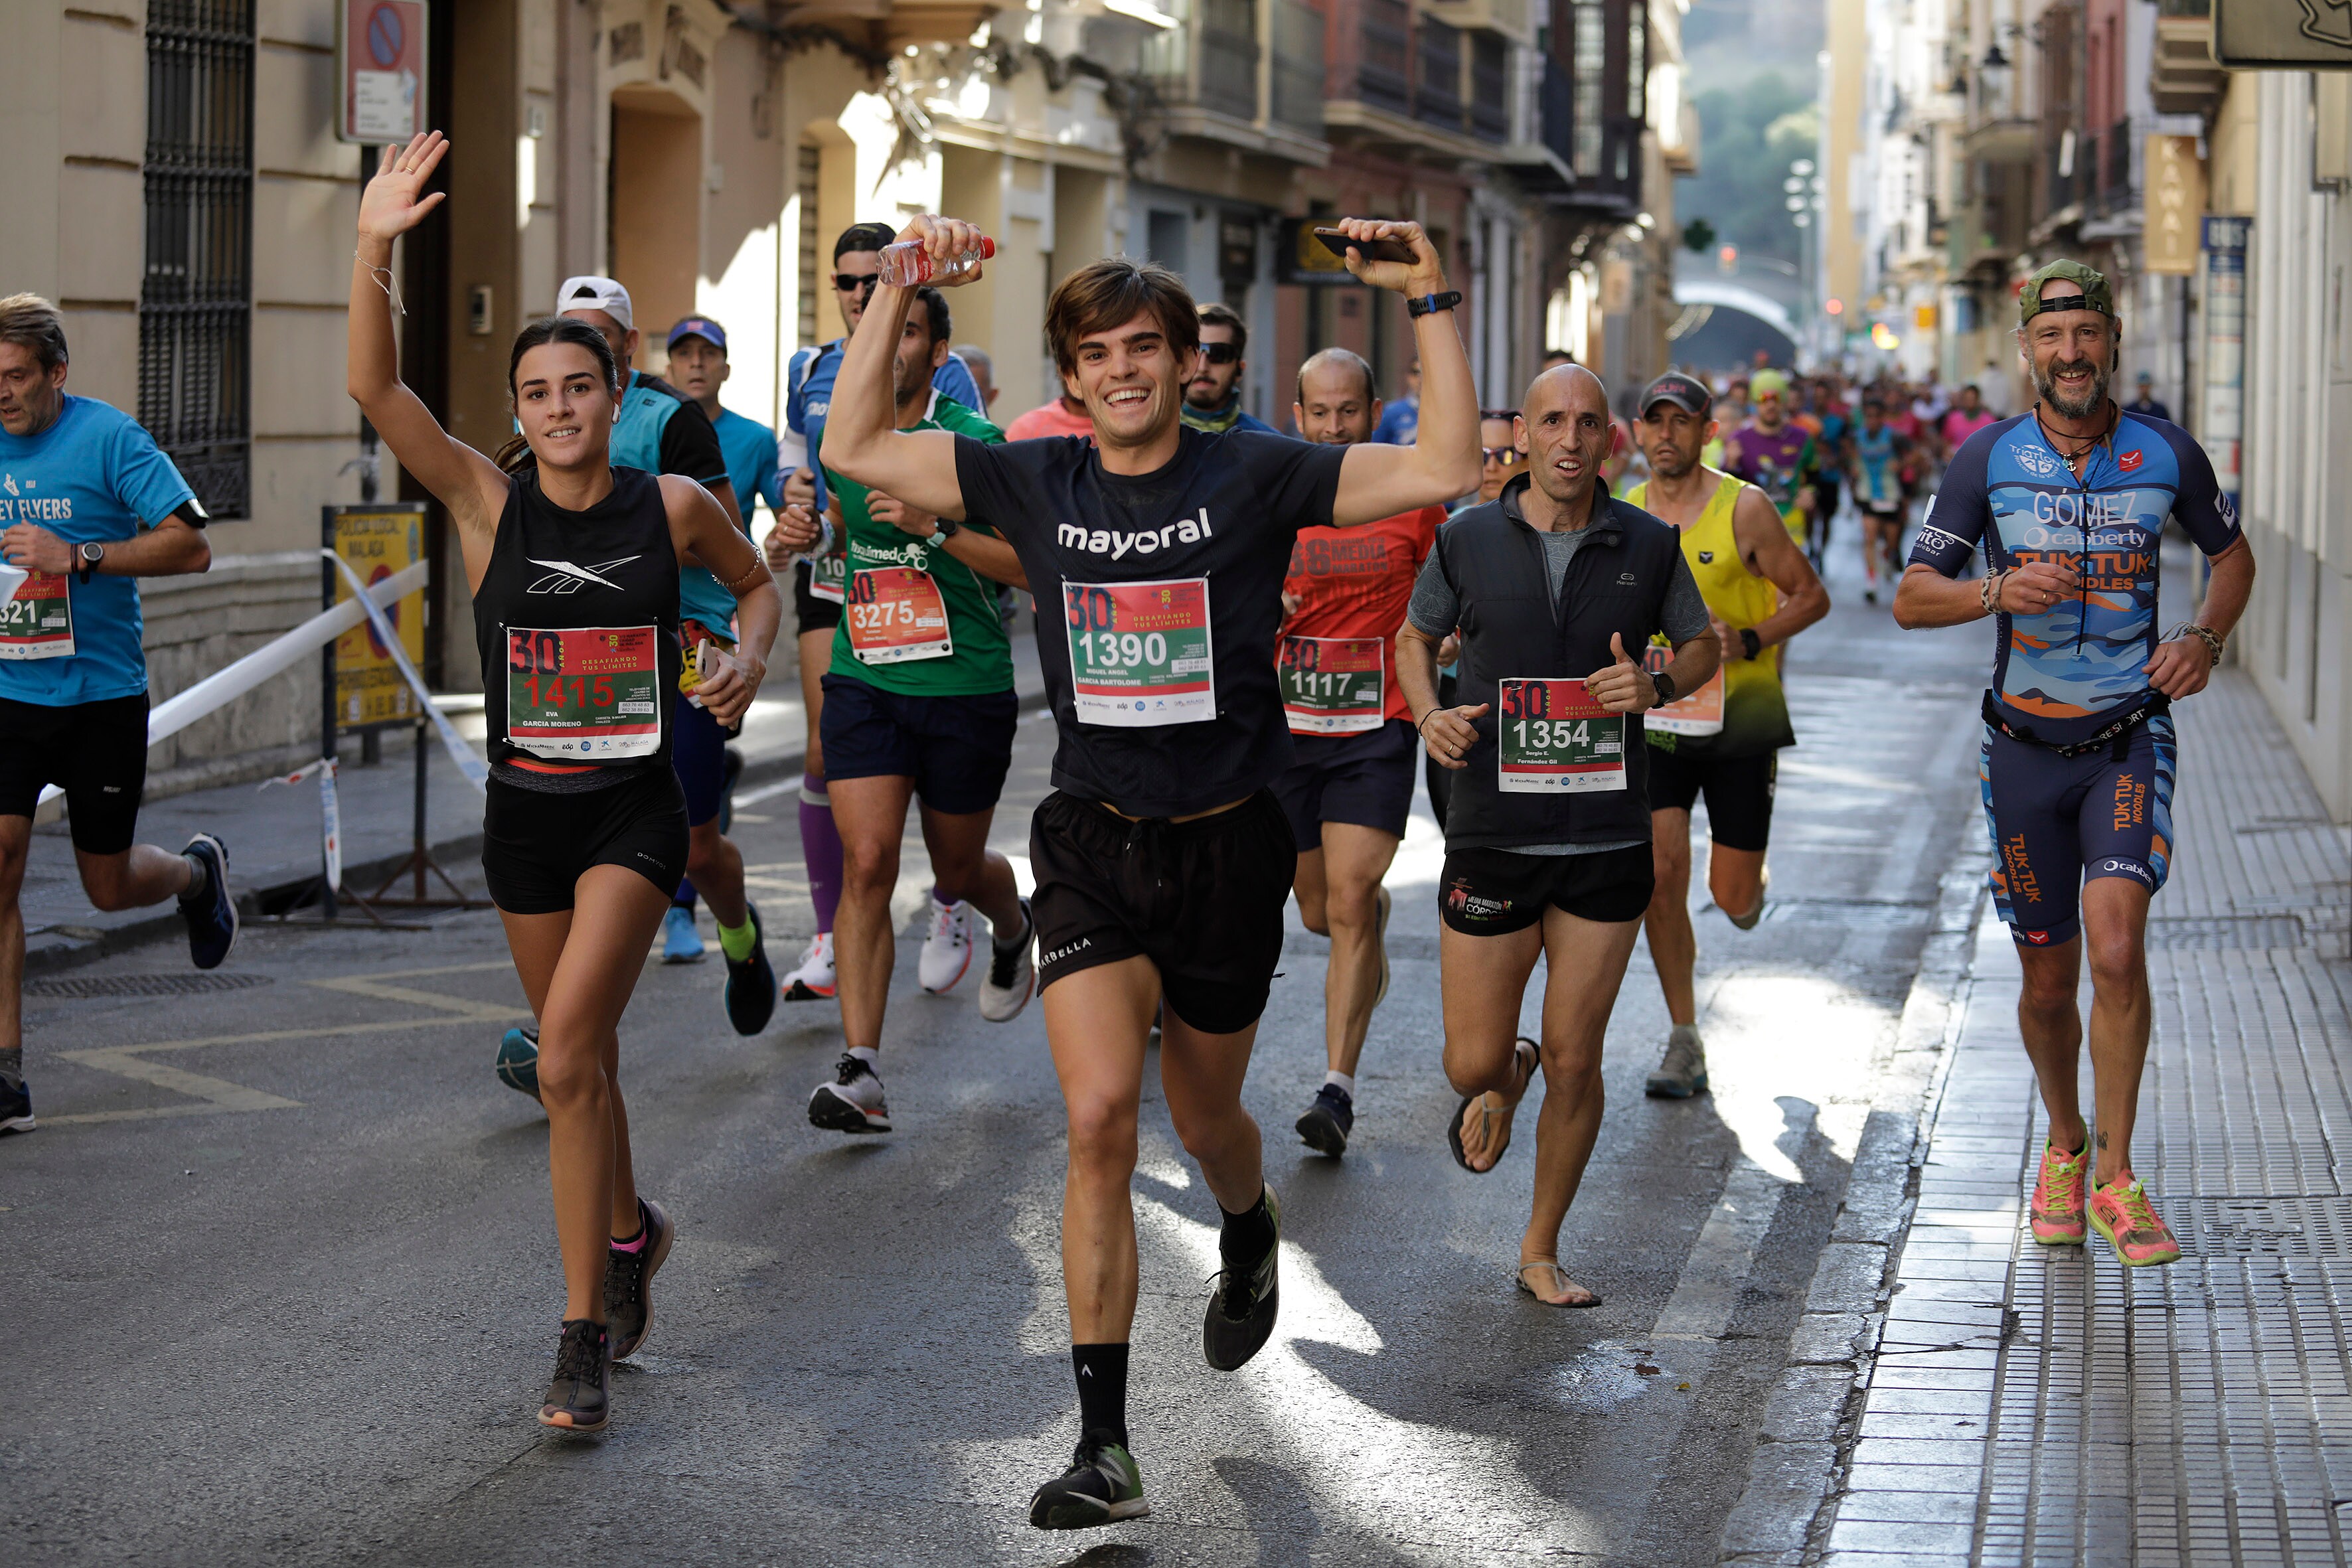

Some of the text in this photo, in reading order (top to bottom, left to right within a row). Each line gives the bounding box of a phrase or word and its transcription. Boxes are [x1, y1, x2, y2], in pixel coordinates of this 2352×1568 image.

[18, 498, 72, 520] FLYERS
[2034, 488, 2139, 526] GÓMEZ
[1058, 507, 1212, 562] mayoral
[2051, 530, 2146, 548] cabberty
[1331, 544, 1386, 561] MEDIA
[2090, 553, 2152, 574] TUK
[1067, 586, 1114, 631] 30
[1162, 589, 1171, 603] 30
[854, 600, 914, 629] 3275
[1134, 612, 1191, 622] DESAFIANDO
[510, 629, 561, 675] 30
[609, 635, 618, 647] 30
[1079, 632, 1167, 666] 1390
[1282, 637, 1318, 672] 30
[524, 676, 615, 708] 1415
[1291, 671, 1352, 696] 1117
[1502, 680, 1548, 719] 30
[1514, 720, 1590, 748] 1354
[2114, 773, 2133, 831] TUK TUK
[2133, 783, 2146, 824] NOODLES
[2003, 844, 2022, 894] NOODLES
[2010, 833, 2042, 903] TUK TUK
[1467, 896, 1502, 910] MEDIA MARATÓN
